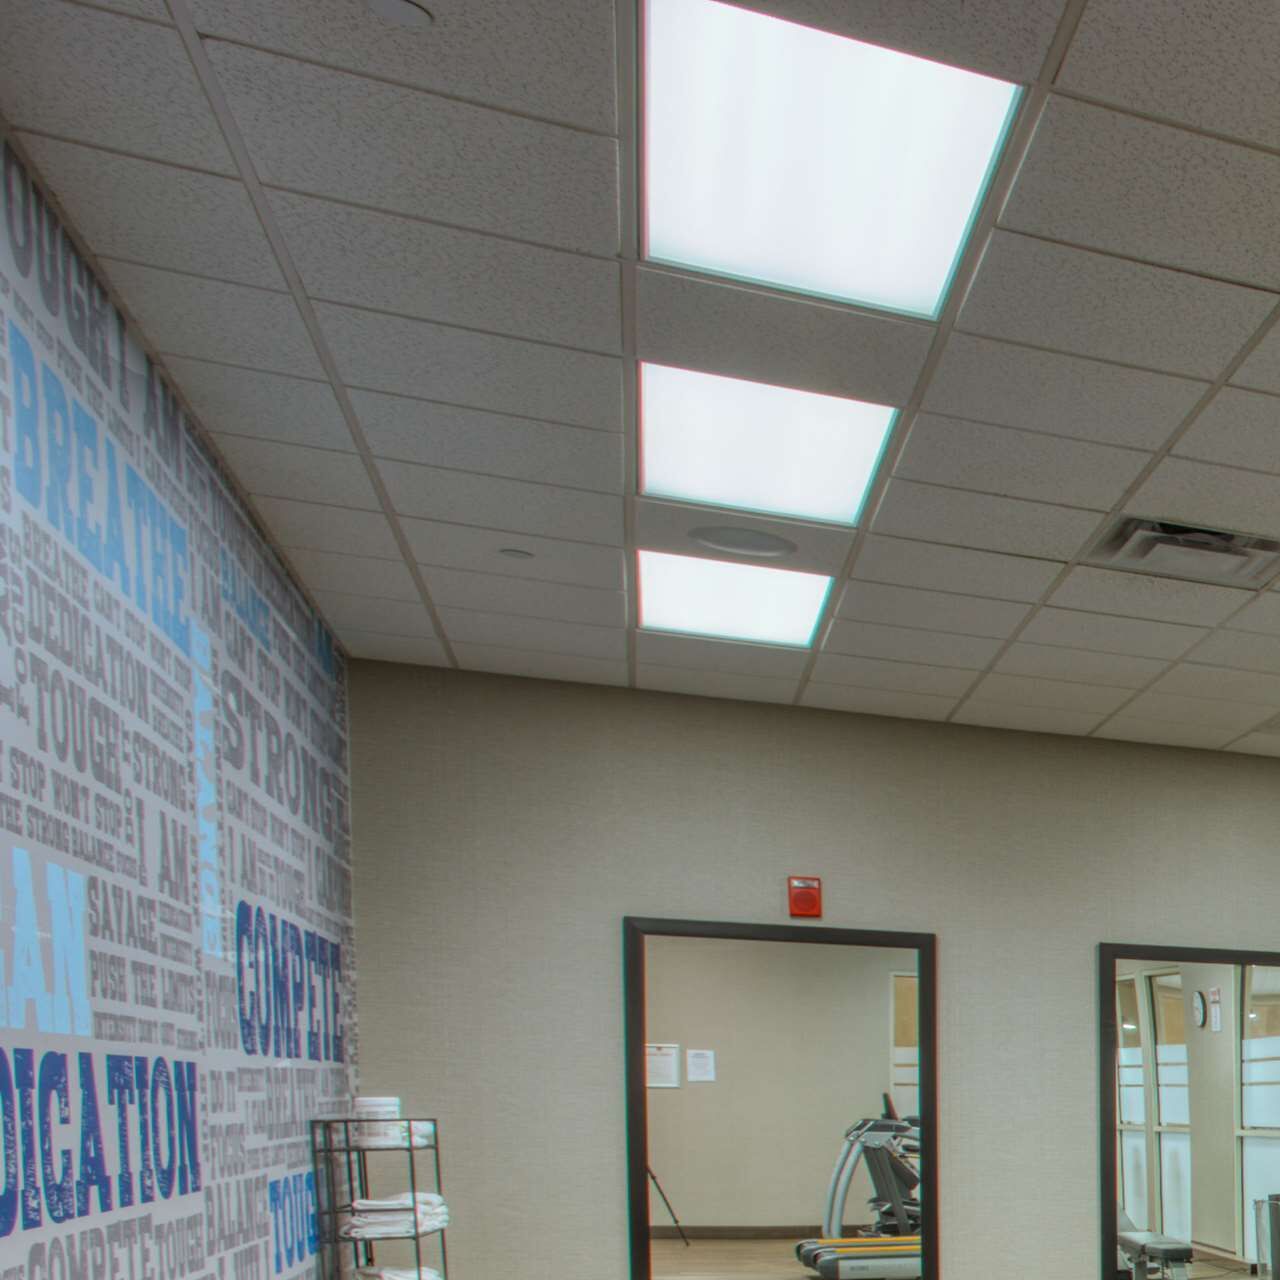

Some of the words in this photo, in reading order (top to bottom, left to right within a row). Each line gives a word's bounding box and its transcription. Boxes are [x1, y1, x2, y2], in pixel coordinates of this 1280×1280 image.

[5, 142, 113, 394] OUGH
[8, 319, 191, 659] BREATHE
[22, 506, 88, 613] BREATHE
[26, 558, 148, 730] DEDICATION
[9, 744, 45, 803] STOP
[50, 768, 89, 825] WON'T
[93, 792, 122, 841] STOP
[28, 645, 121, 799] TOUGH
[132, 724, 187, 816] STRONG
[221, 669, 333, 846] STRONG
[86, 866, 157, 958] SAVAGE
[157, 807, 190, 907] AM
[0, 847, 93, 1037] AN
[87, 949, 126, 1003] PUSH
[130, 958, 156, 1009] THE
[235, 900, 345, 1063] COMPETE
[204, 1173, 269, 1258] BALANCE
[269, 1172, 320, 1274] TOUG
